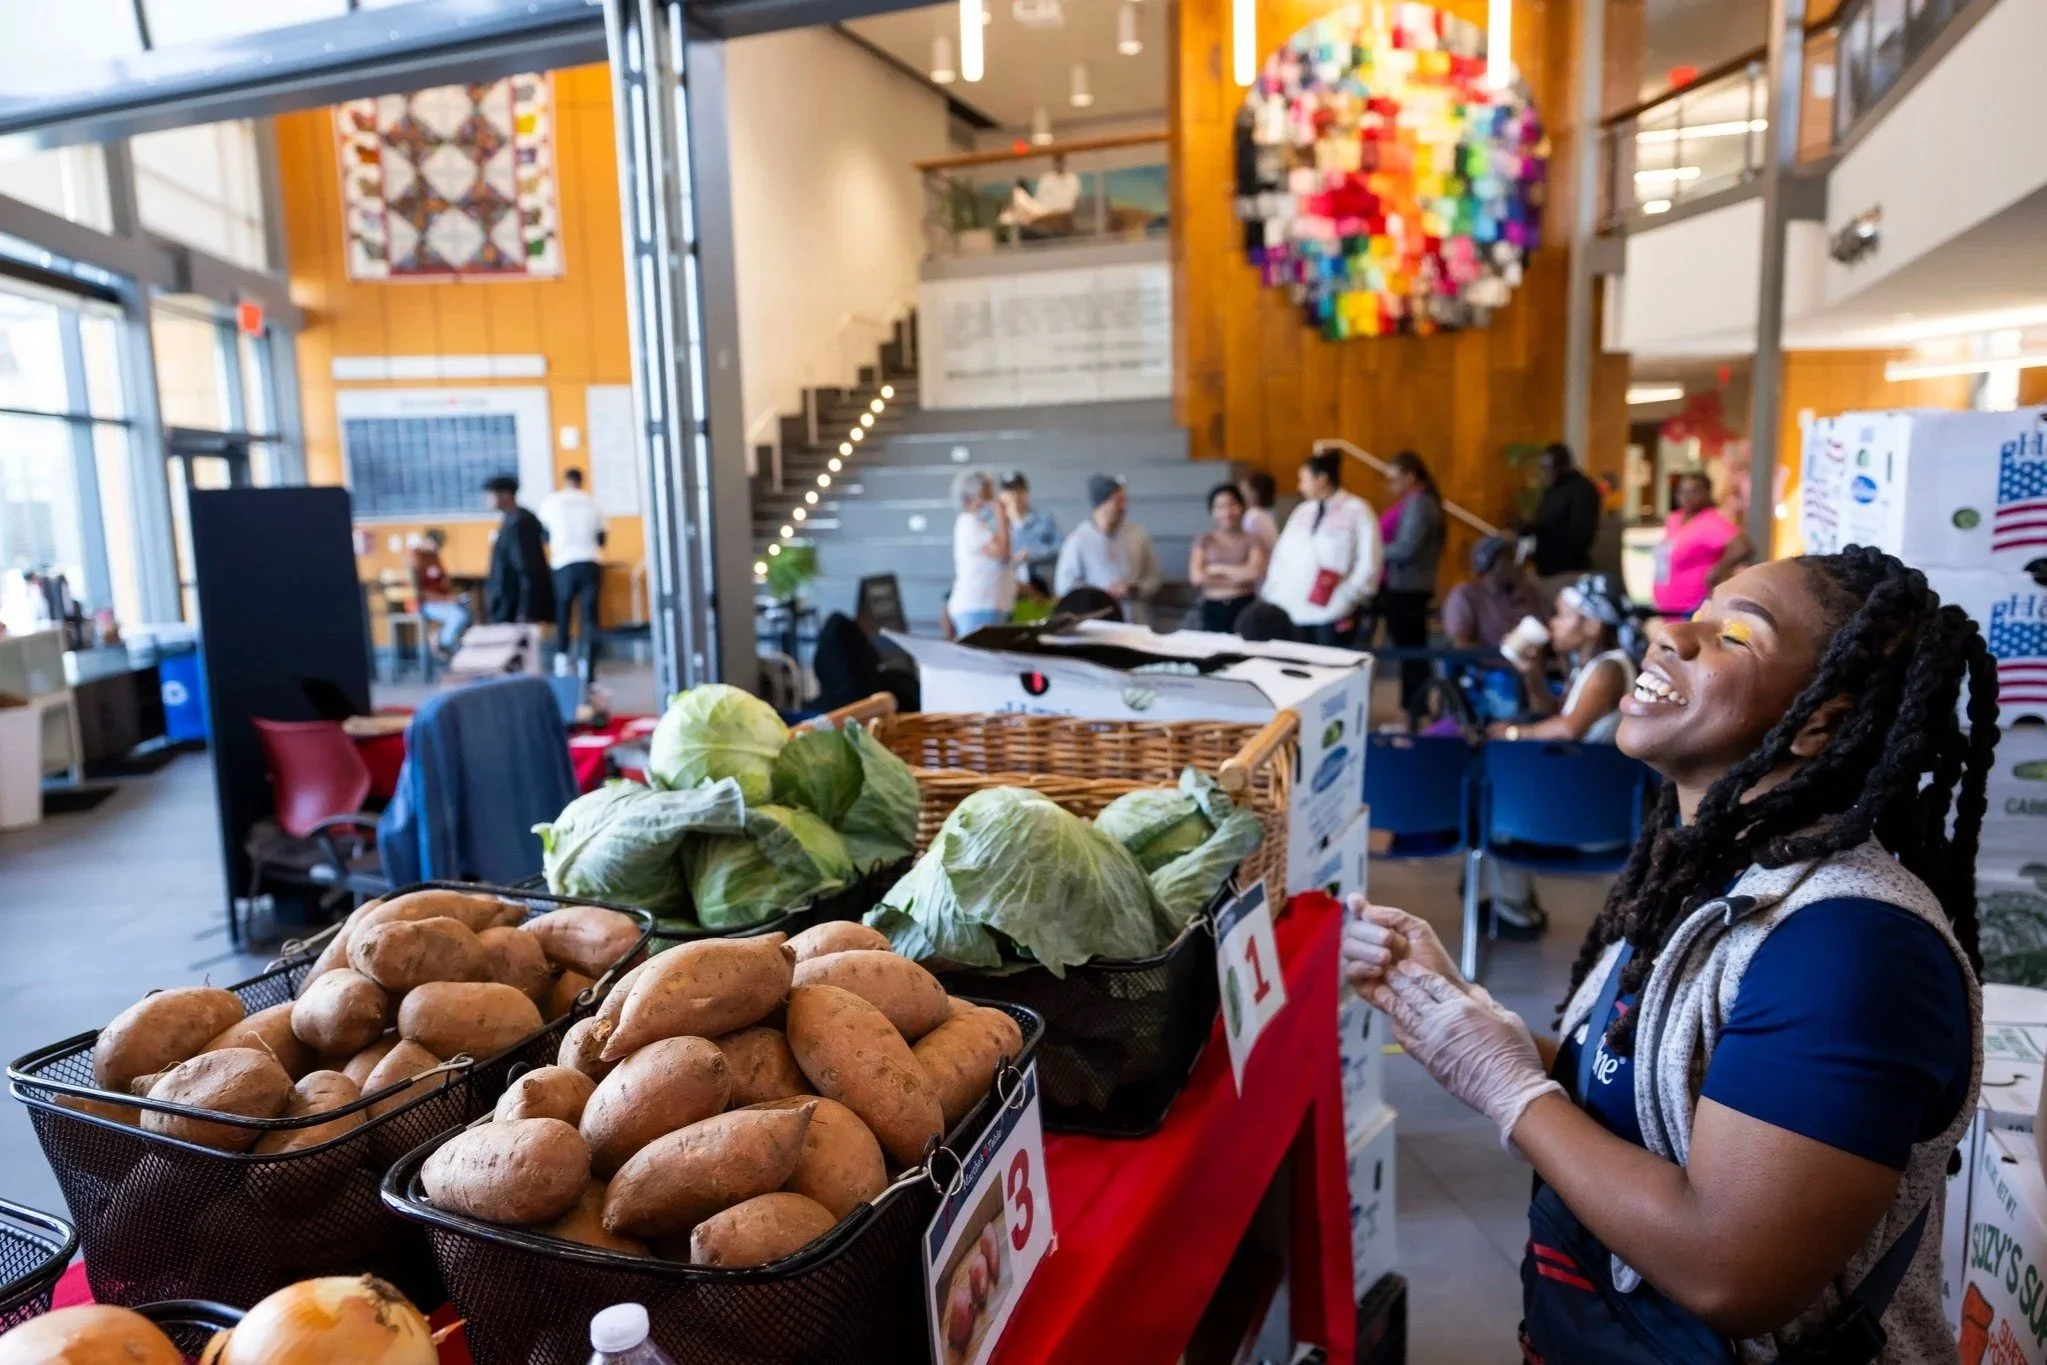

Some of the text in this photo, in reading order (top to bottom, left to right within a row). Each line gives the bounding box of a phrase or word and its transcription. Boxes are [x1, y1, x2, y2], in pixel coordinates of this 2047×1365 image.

[1245, 934, 1271, 1006] 1
[1007, 1148, 1034, 1251] 3
[1971, 1222, 2023, 1294] SUZY'S
